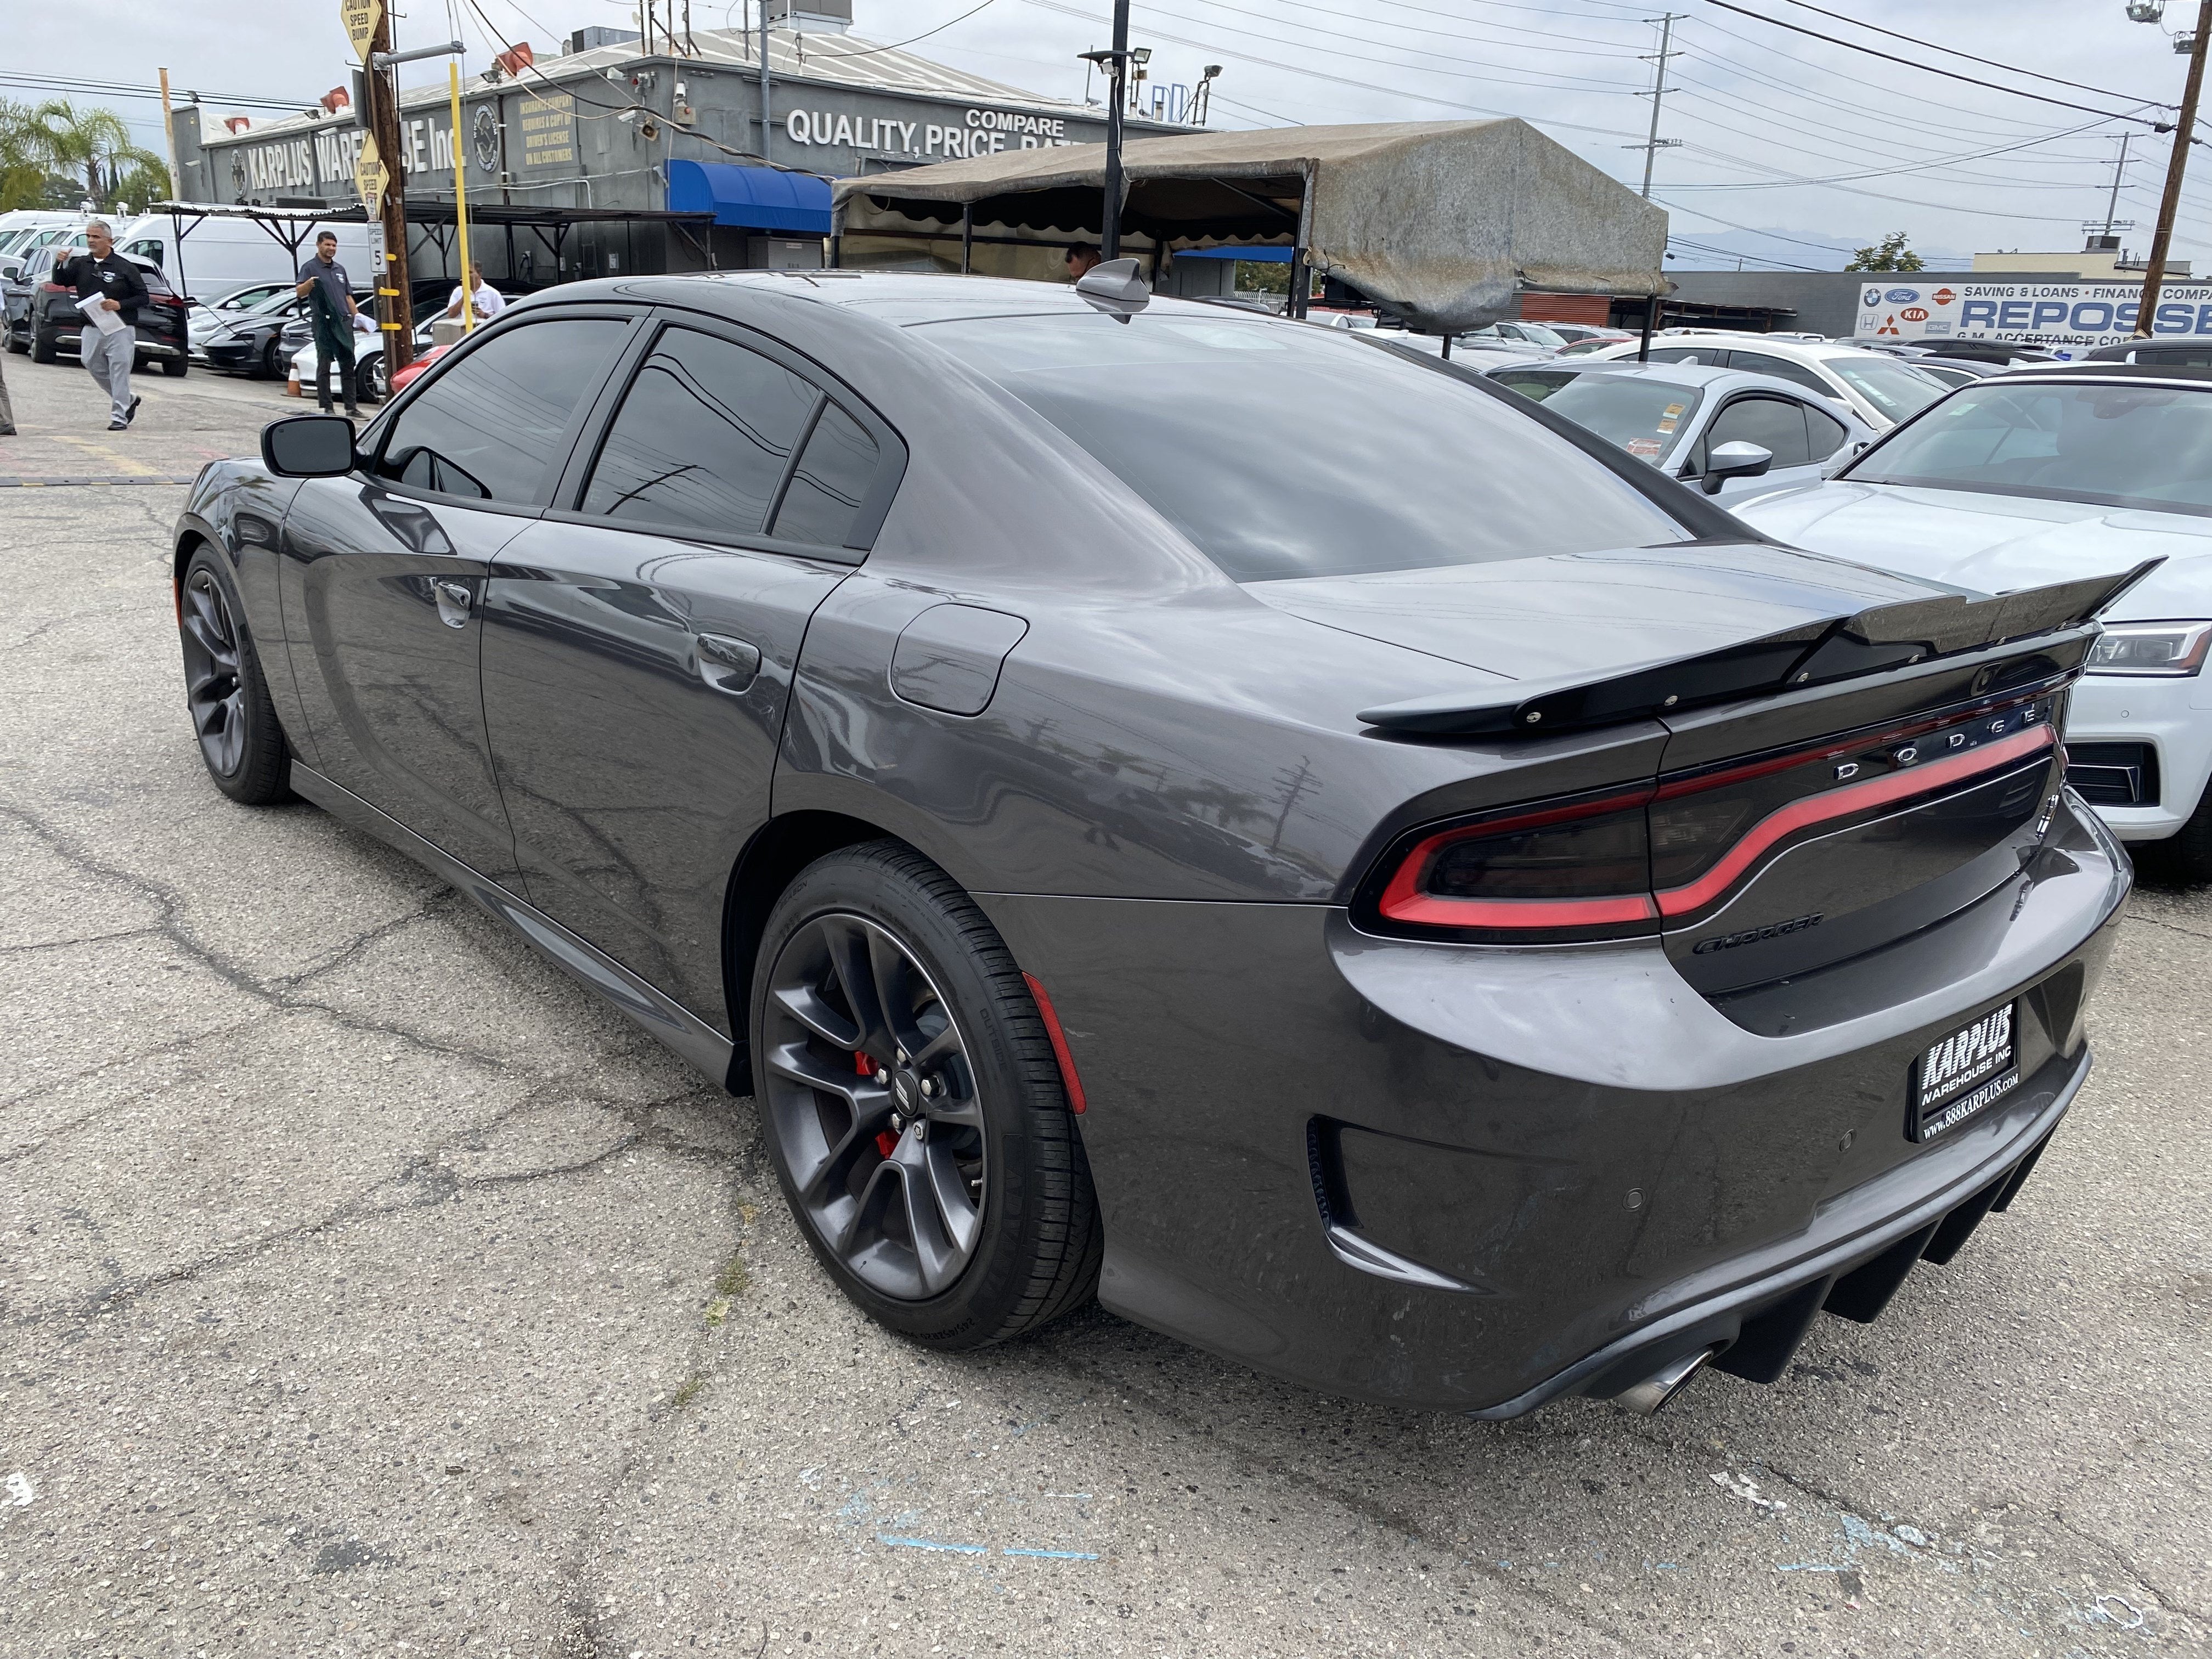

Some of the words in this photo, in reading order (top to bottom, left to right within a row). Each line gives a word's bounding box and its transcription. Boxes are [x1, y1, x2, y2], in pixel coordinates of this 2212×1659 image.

[345, 0, 370, 11] CAUTION
[349, 12, 368, 26] SPEED
[352, 27, 369, 41] BUMP
[965, 109, 1064, 137] COMPARE
[548, 131, 569, 145] LICENSE
[786, 109, 922, 159] QUALITY,
[924, 124, 1006, 159] PRICE
[533, 151, 541, 164] ALL
[541, 148, 572, 163] CUSTOMERS
[247, 139, 313, 190] KARPLUS
[364, 179, 377, 191] SPEED
[375, 250, 381, 266] 5
[1892, 291, 1912, 301] Ford
[1964, 286, 2015, 297] SAVING
[2020, 287, 2028, 297] &
[2032, 287, 2079, 298] LOANS
[2093, 288, 2145, 299] FINAN
[1903, 309, 1925, 319] KIA
[1833, 708, 2035, 780] DODGE
[1692, 911, 1825, 955] CHARGER
[1922, 1003, 2013, 1090] KARPLUS
